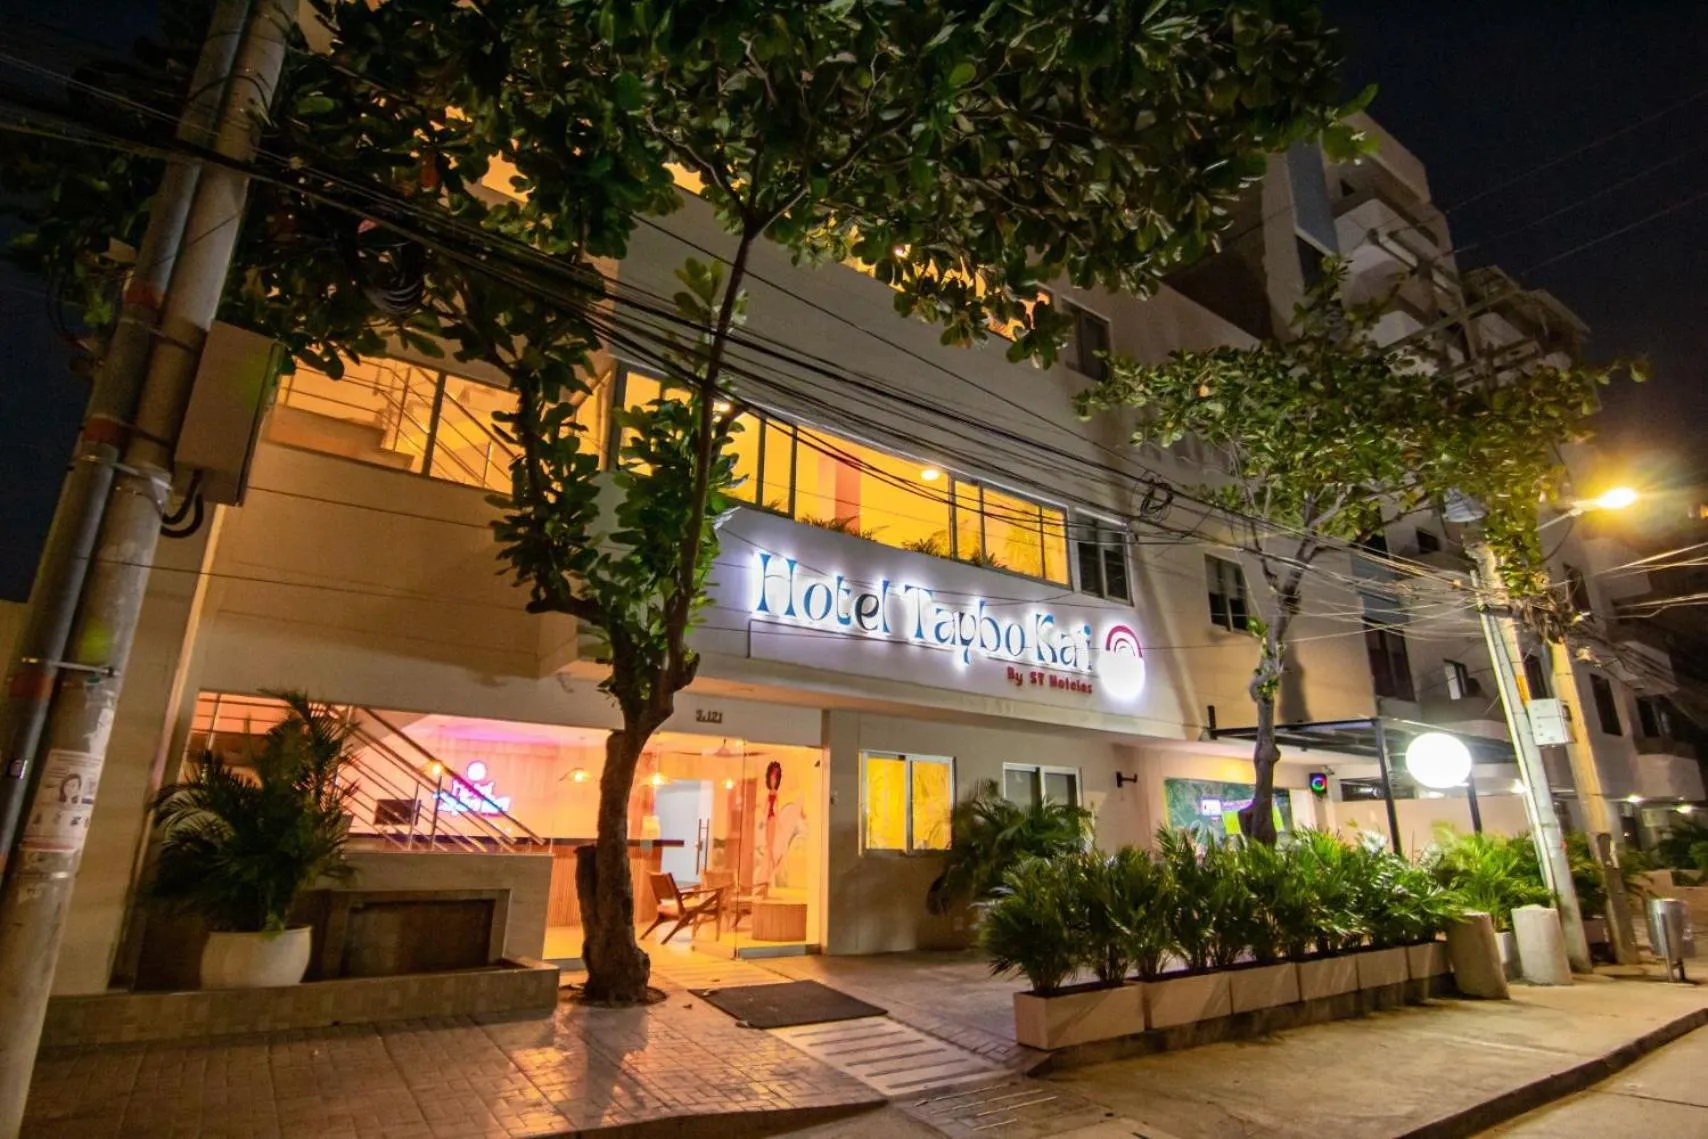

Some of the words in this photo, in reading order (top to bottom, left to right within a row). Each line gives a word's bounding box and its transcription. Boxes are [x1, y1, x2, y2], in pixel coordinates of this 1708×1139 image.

[756, 553, 891, 634] Hotel
[1035, 612, 1093, 671] Kai
[1007, 666, 1024, 687] By
[1030, 671, 1045, 686] ST
[1049, 674, 1093, 694] Hoteles
